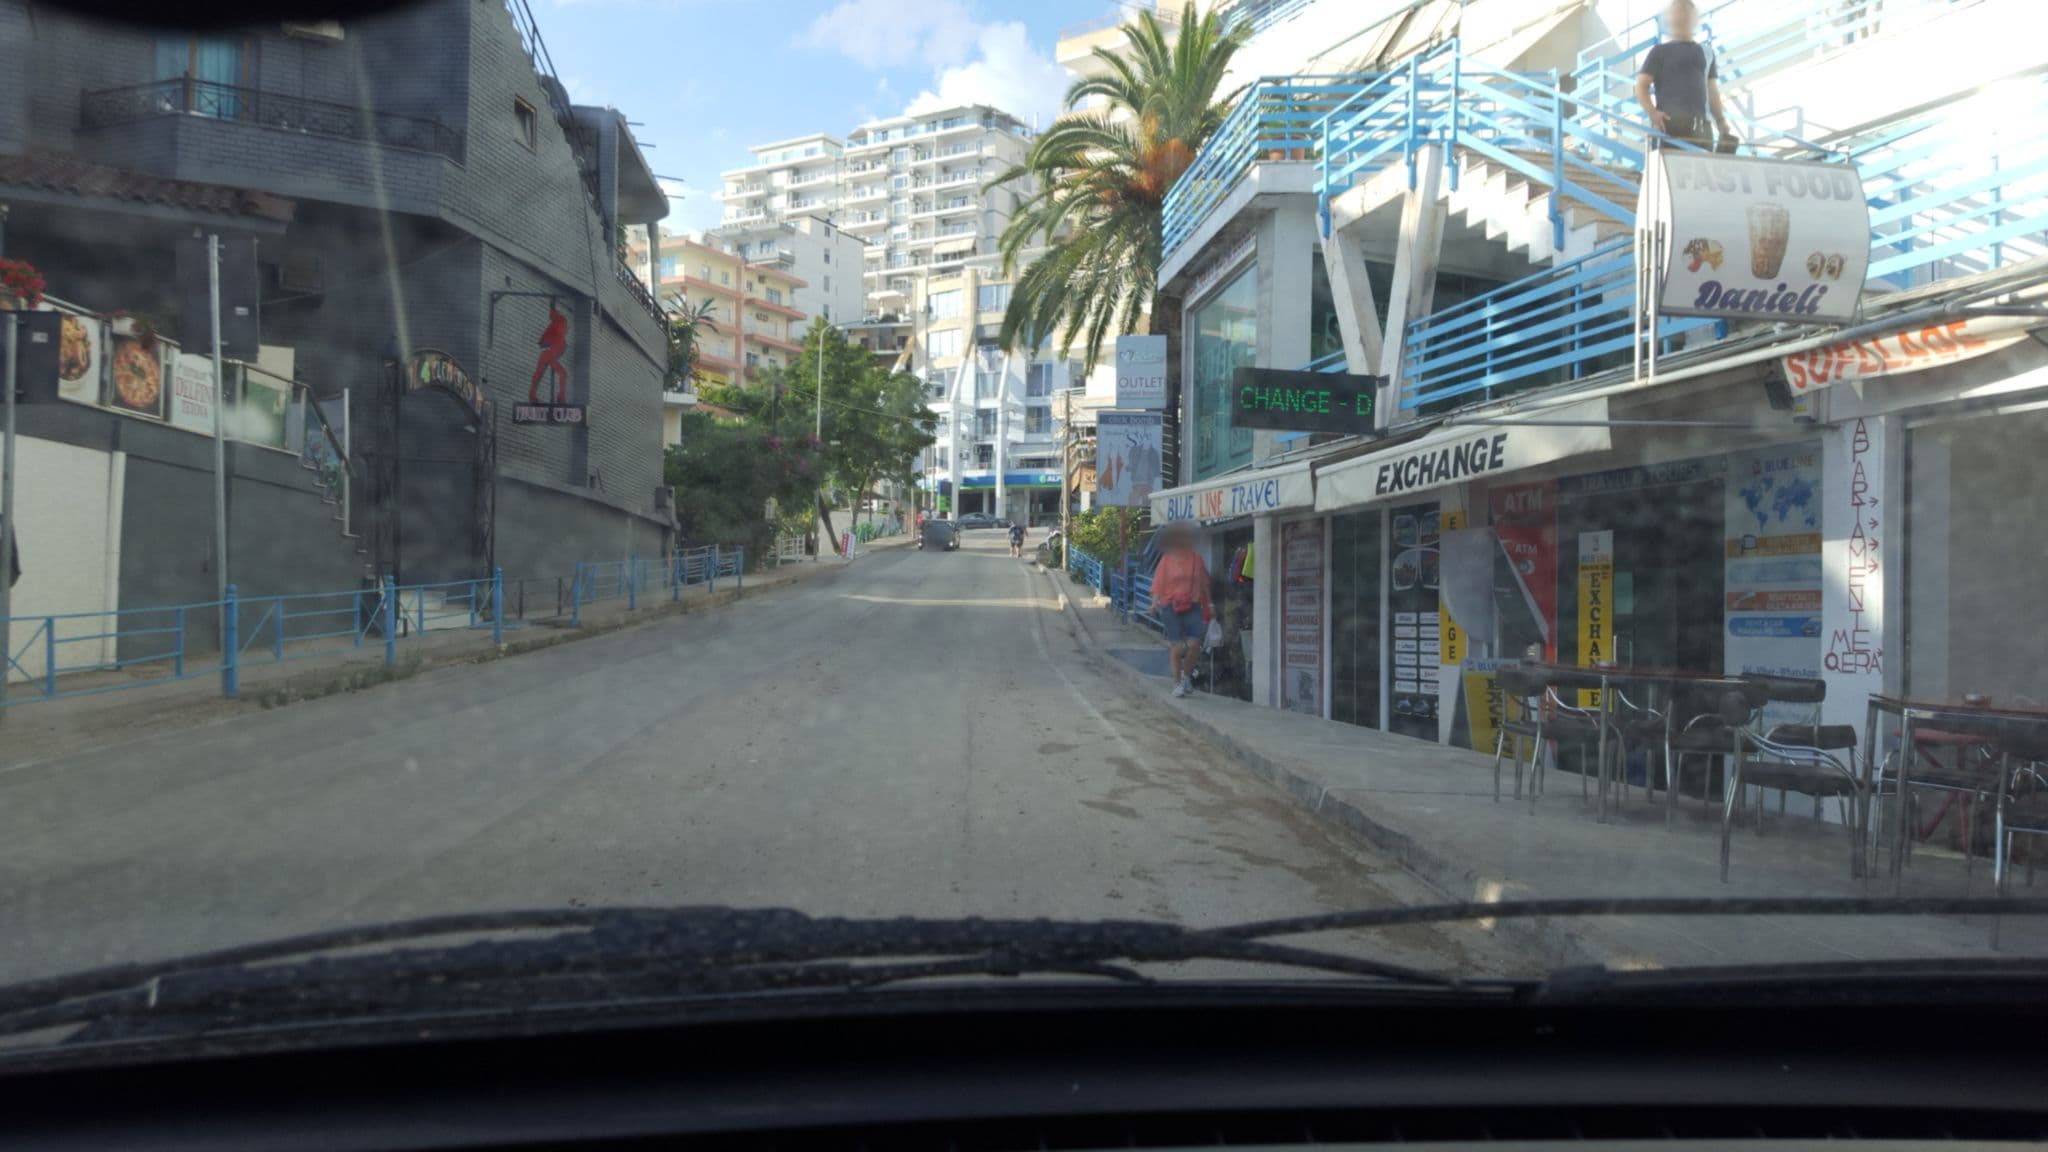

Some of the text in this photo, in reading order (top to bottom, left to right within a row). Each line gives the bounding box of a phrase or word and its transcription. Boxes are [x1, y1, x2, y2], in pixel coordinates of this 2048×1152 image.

[1675, 161, 1855, 200] FAST FOOD
[1694, 280, 1828, 314] Danieli
[1118, 375, 1163, 389] OUTLET
[1240, 386, 1331, 414] CHANGE
[1355, 393, 1372, 416] D
[1375, 432, 1508, 496] EXCHANGE
[1167, 480, 1281, 521] BLUE LINE TRAVEL
[1504, 487, 1543, 513] ATM
